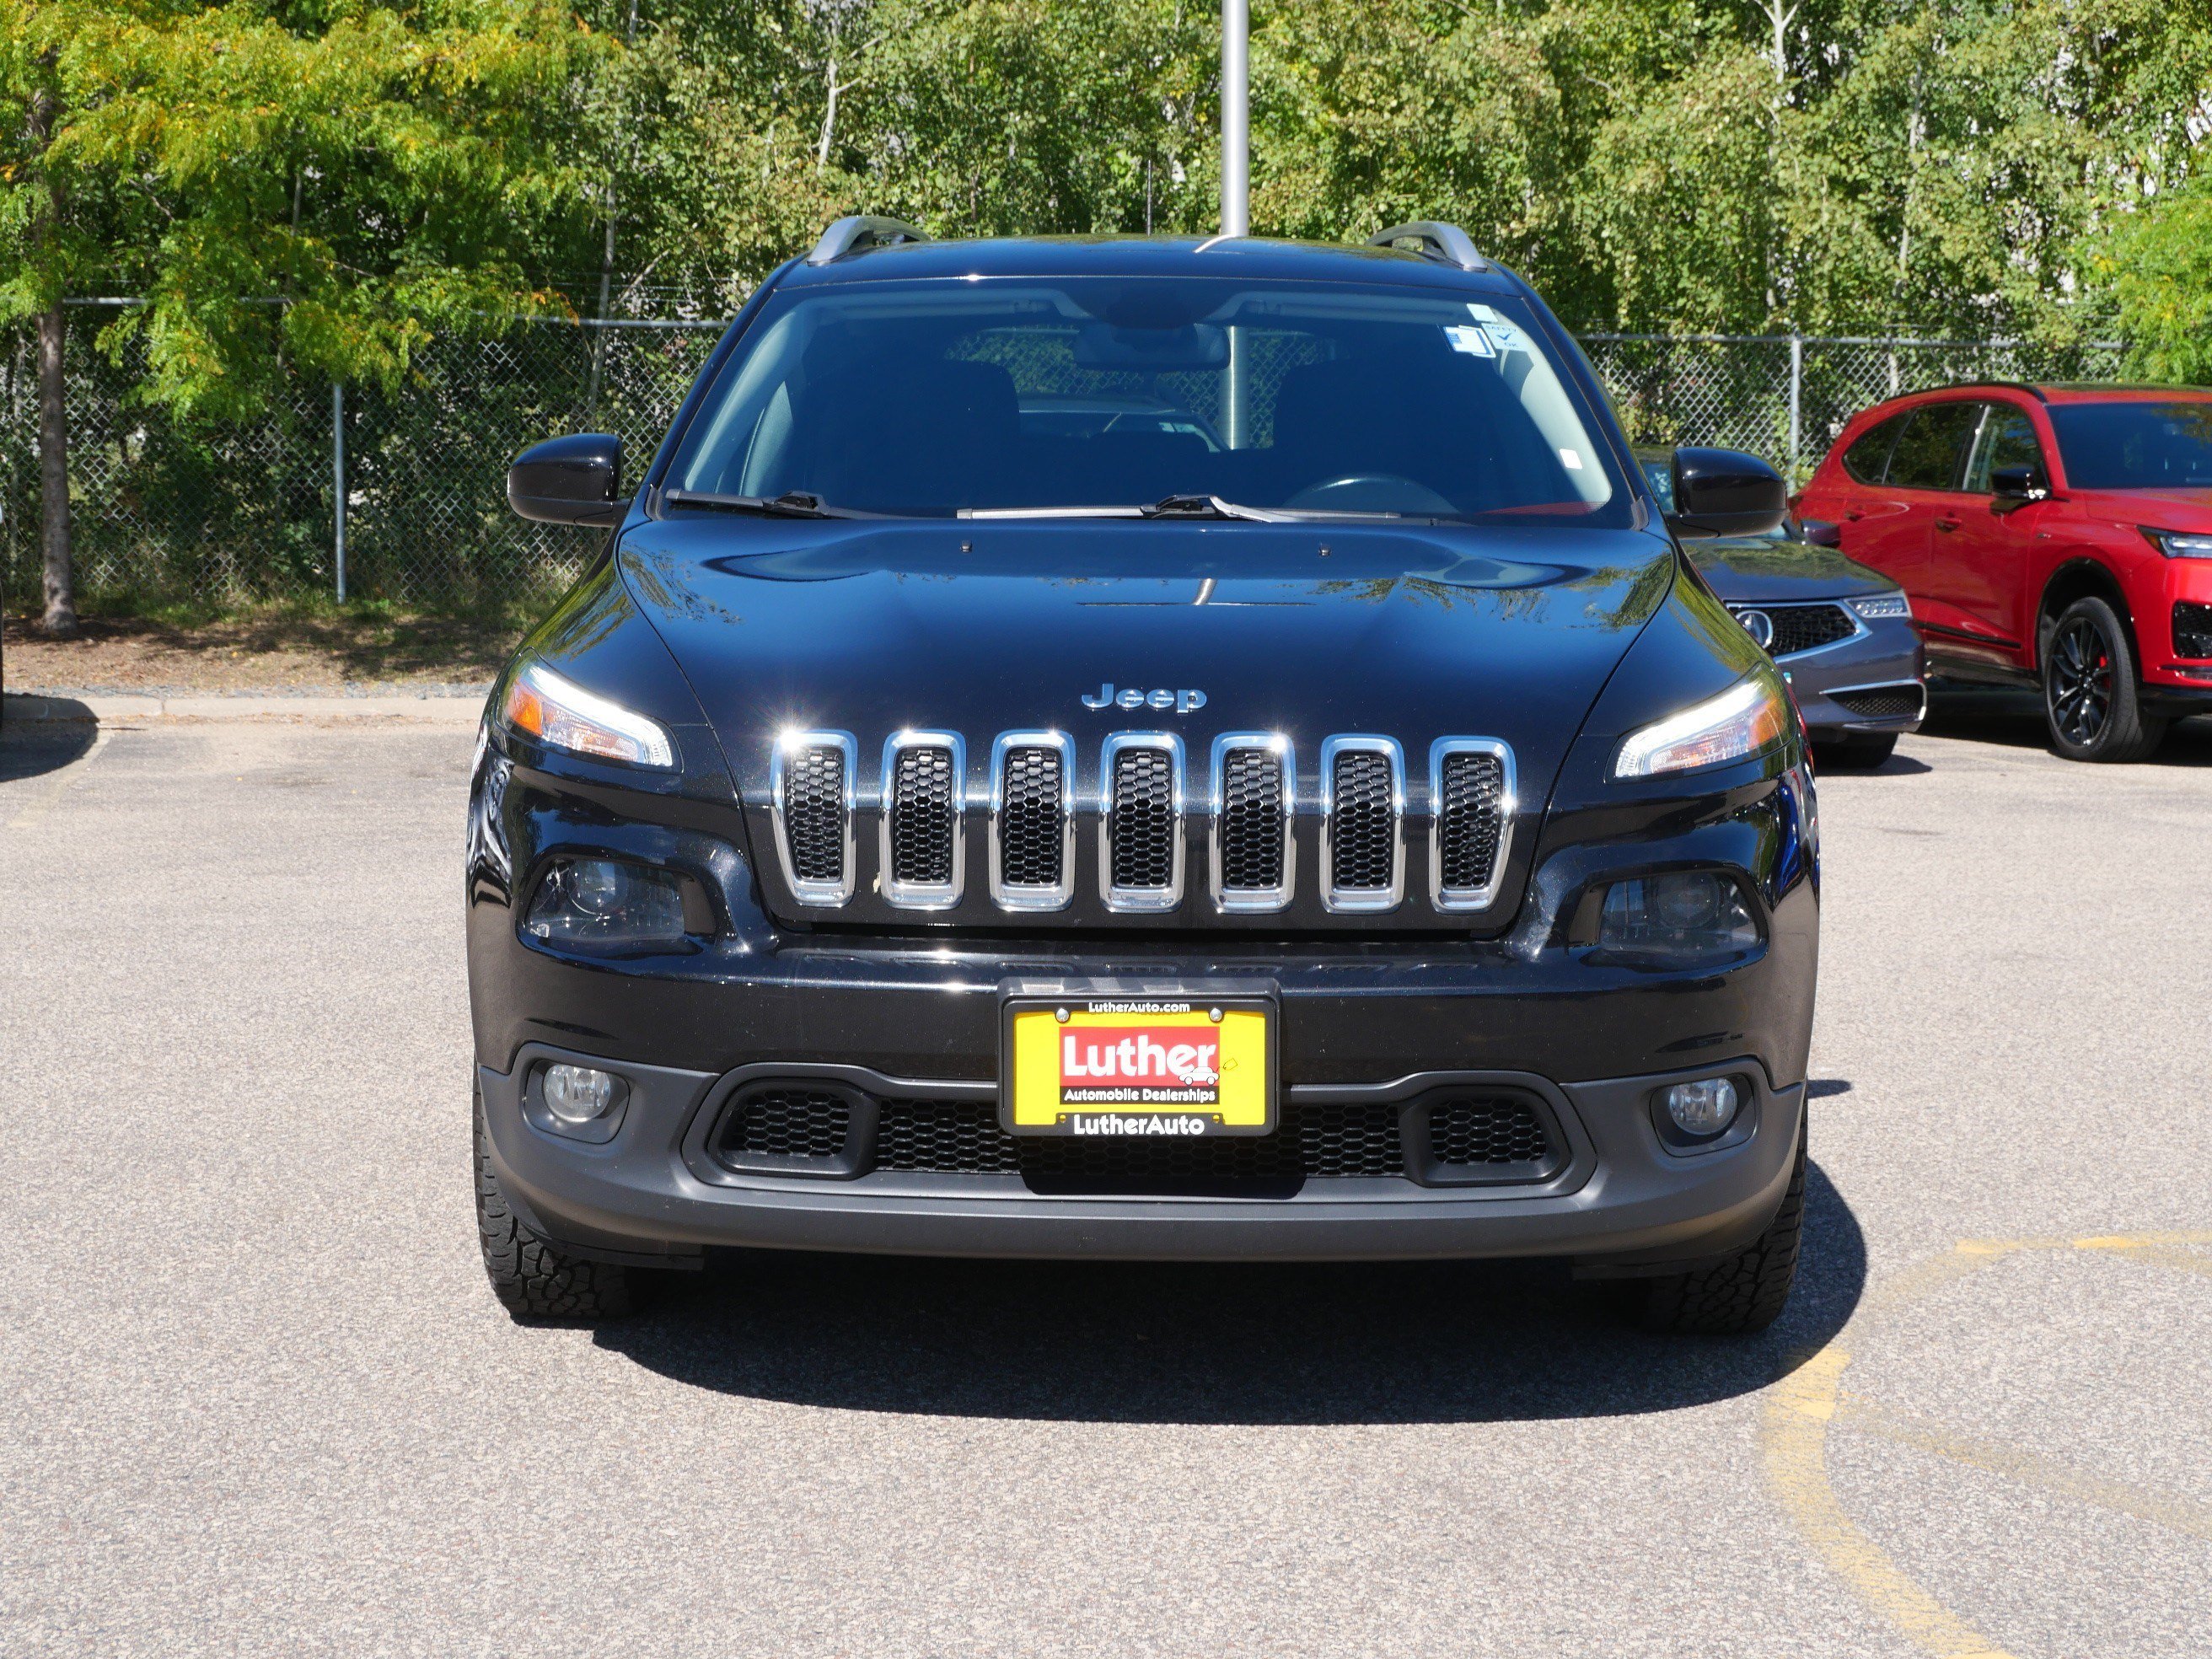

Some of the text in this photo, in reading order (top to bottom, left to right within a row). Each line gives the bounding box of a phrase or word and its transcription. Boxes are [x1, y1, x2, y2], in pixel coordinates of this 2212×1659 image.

[1082, 683, 1207, 713] Jeep
[1088, 1001, 1190, 1013] LutherAuto.com
[1064, 1034, 1216, 1076] Luther
[1064, 1088, 1216, 1103] Automobile Dealerships
[1073, 1114, 1205, 1135] LutherAuto
